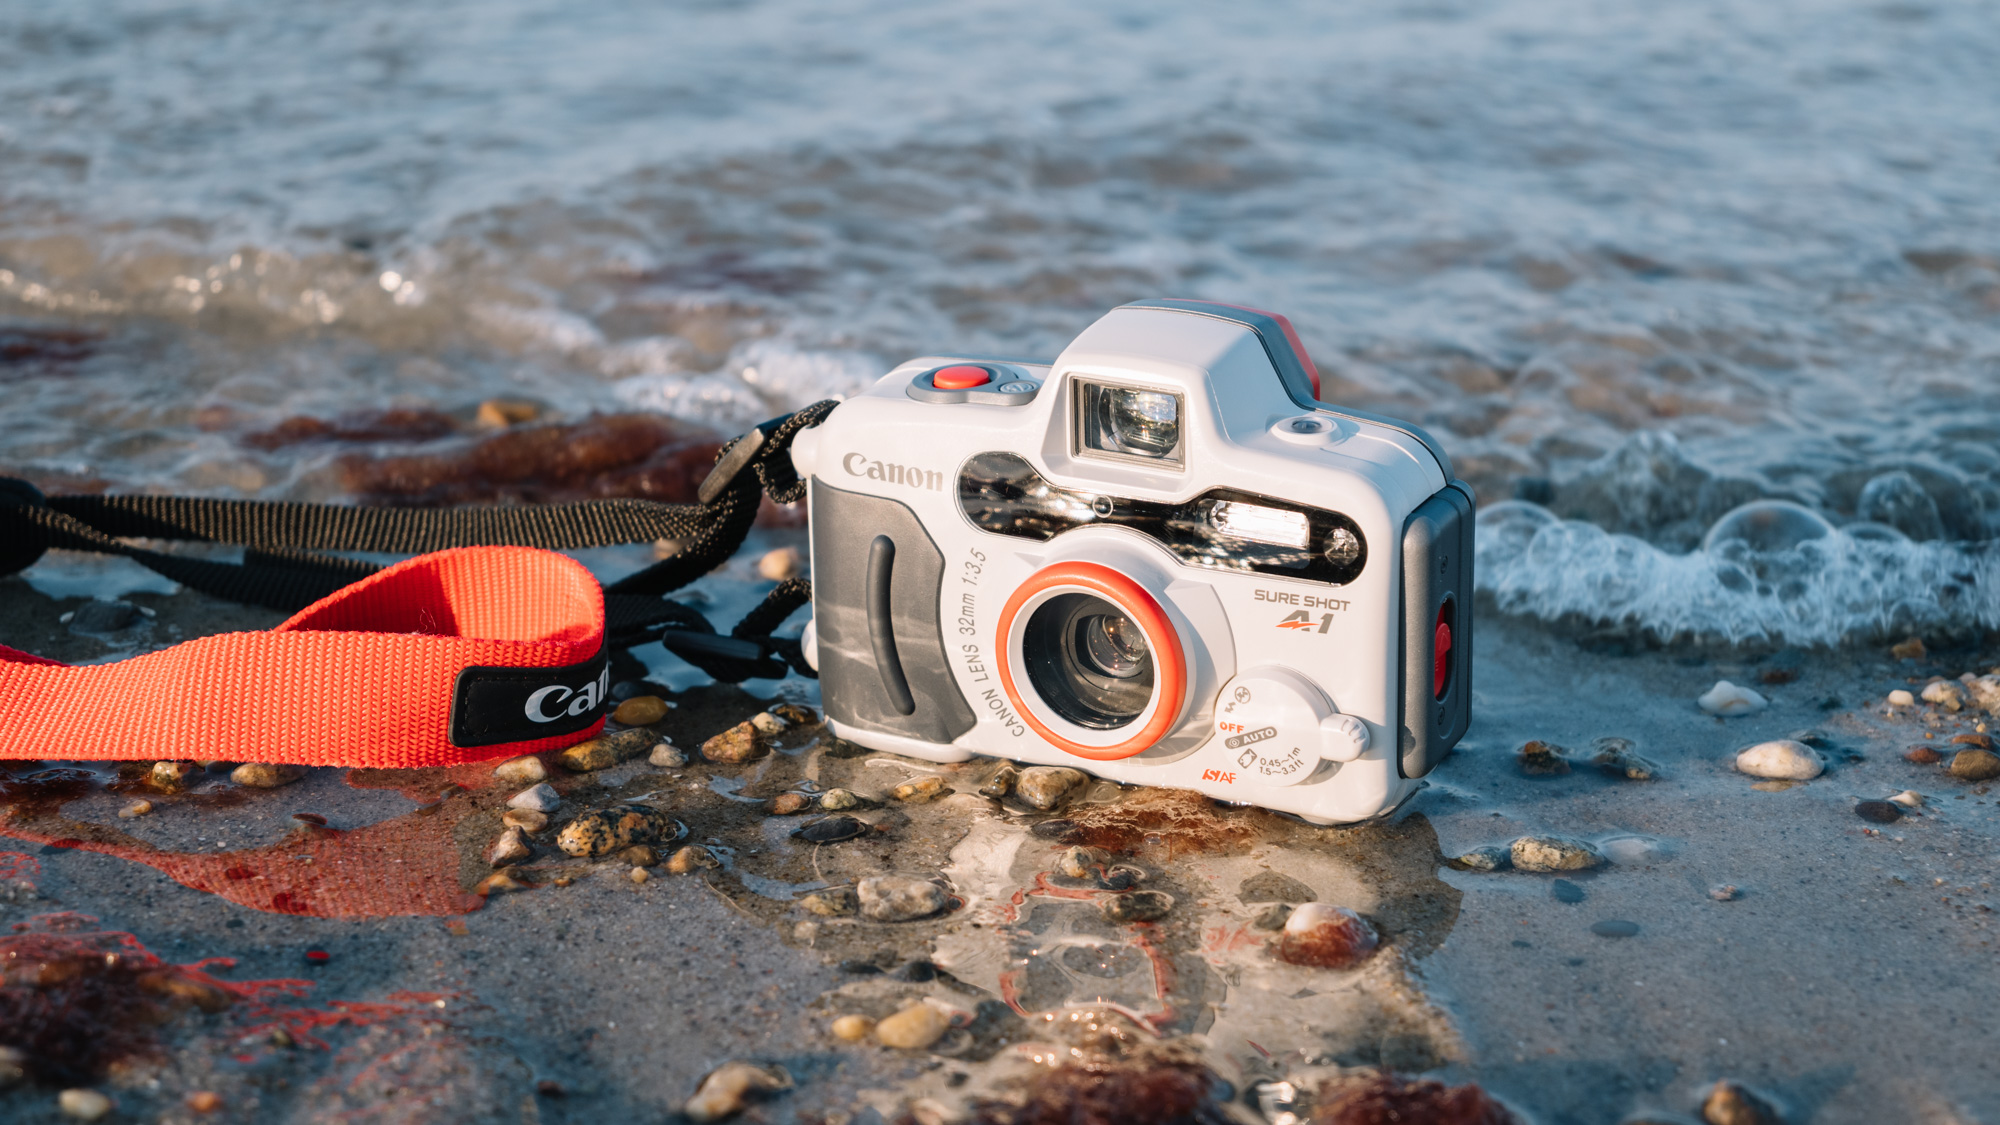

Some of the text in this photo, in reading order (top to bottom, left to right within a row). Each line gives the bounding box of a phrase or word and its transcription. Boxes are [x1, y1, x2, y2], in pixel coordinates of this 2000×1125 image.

[843, 452, 943, 492] Canon
[1254, 589, 1351, 611] SURE SHOT
[958, 547, 1025, 738] CANON LENS 32mm 1:3.5
[1219, 721, 1245, 734] OFF
[1243, 728, 1275, 744] AUTO
